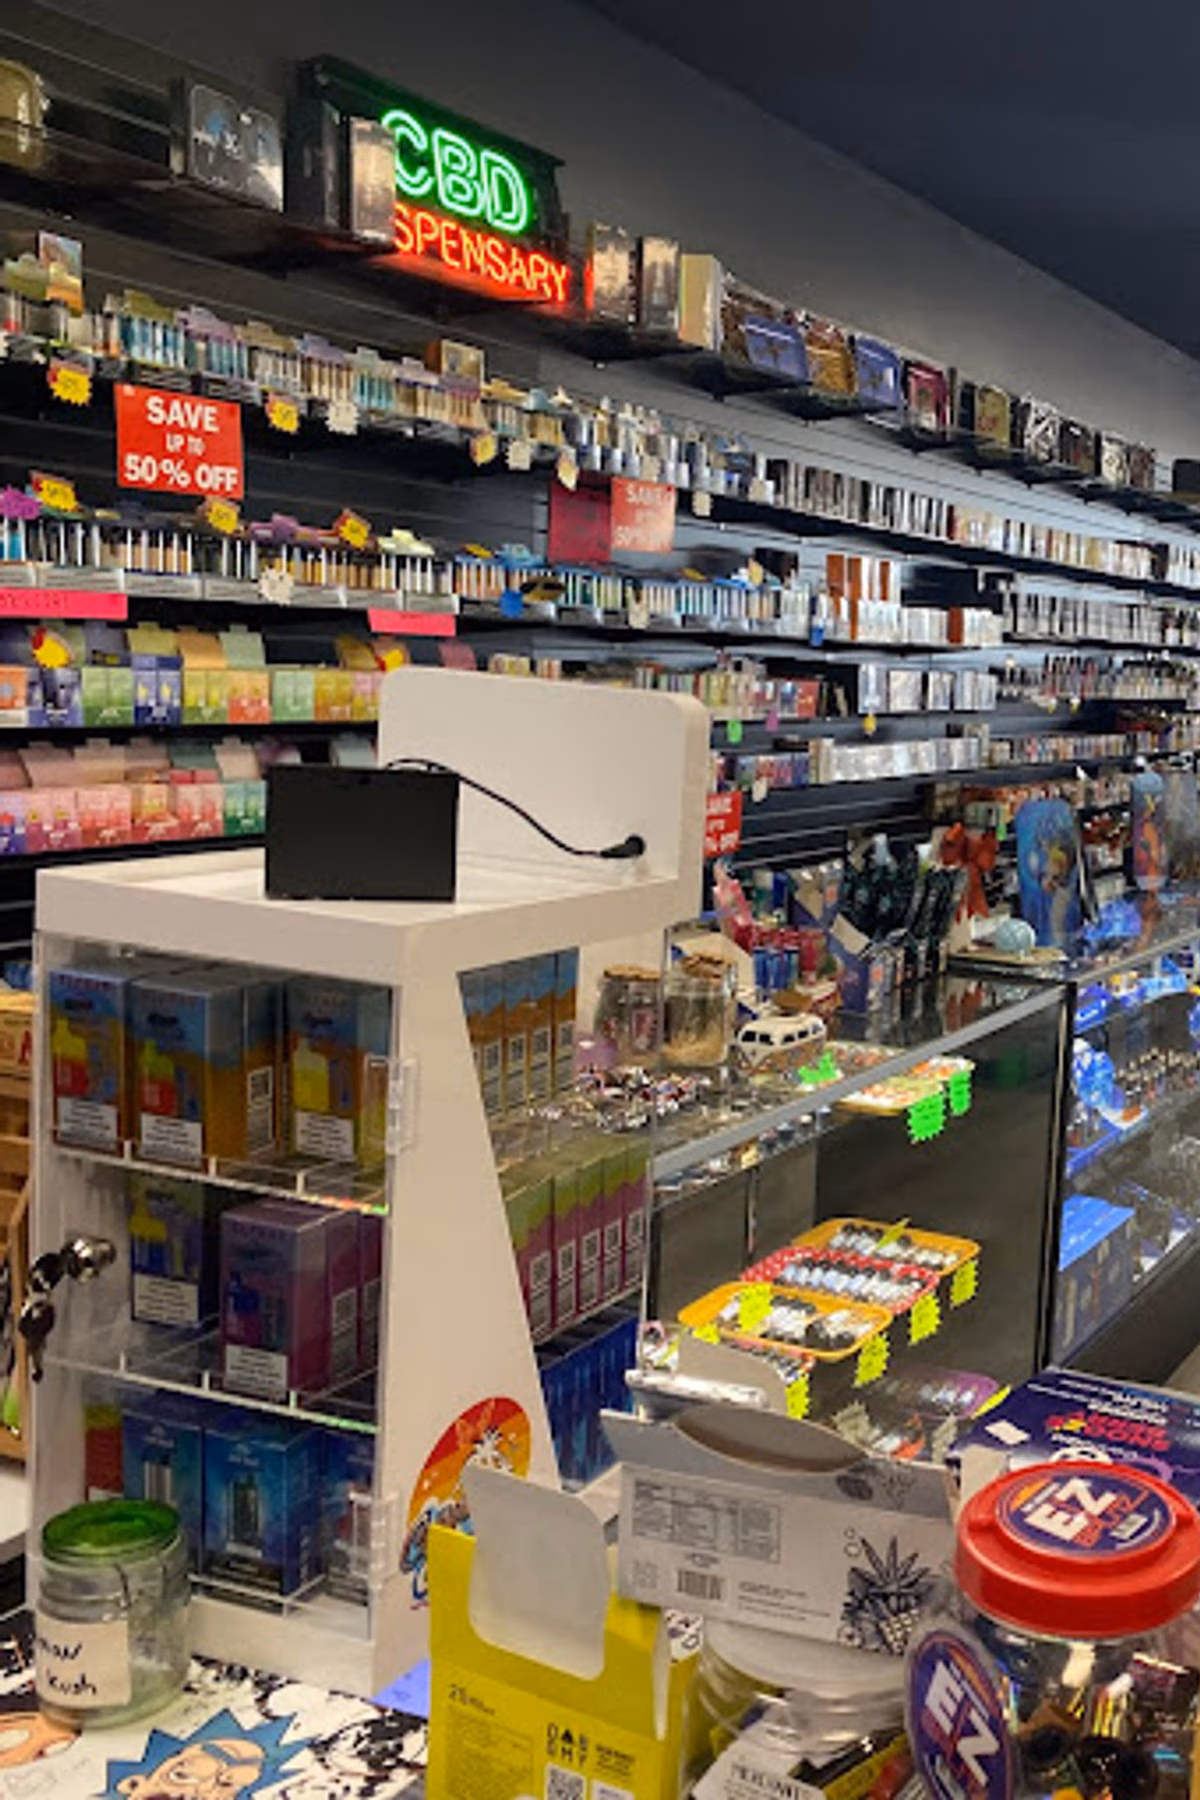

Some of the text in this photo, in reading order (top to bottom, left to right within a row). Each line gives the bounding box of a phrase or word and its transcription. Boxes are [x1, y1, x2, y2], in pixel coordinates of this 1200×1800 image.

[381, 109, 528, 233] CBD
[146, 395, 219, 432] SAVE
[166, 433, 205, 456] UP TO
[195, 463, 238, 491] OFF
[1024, 1477, 1118, 1541] EZ
[925, 1660, 1000, 1788] EZ
